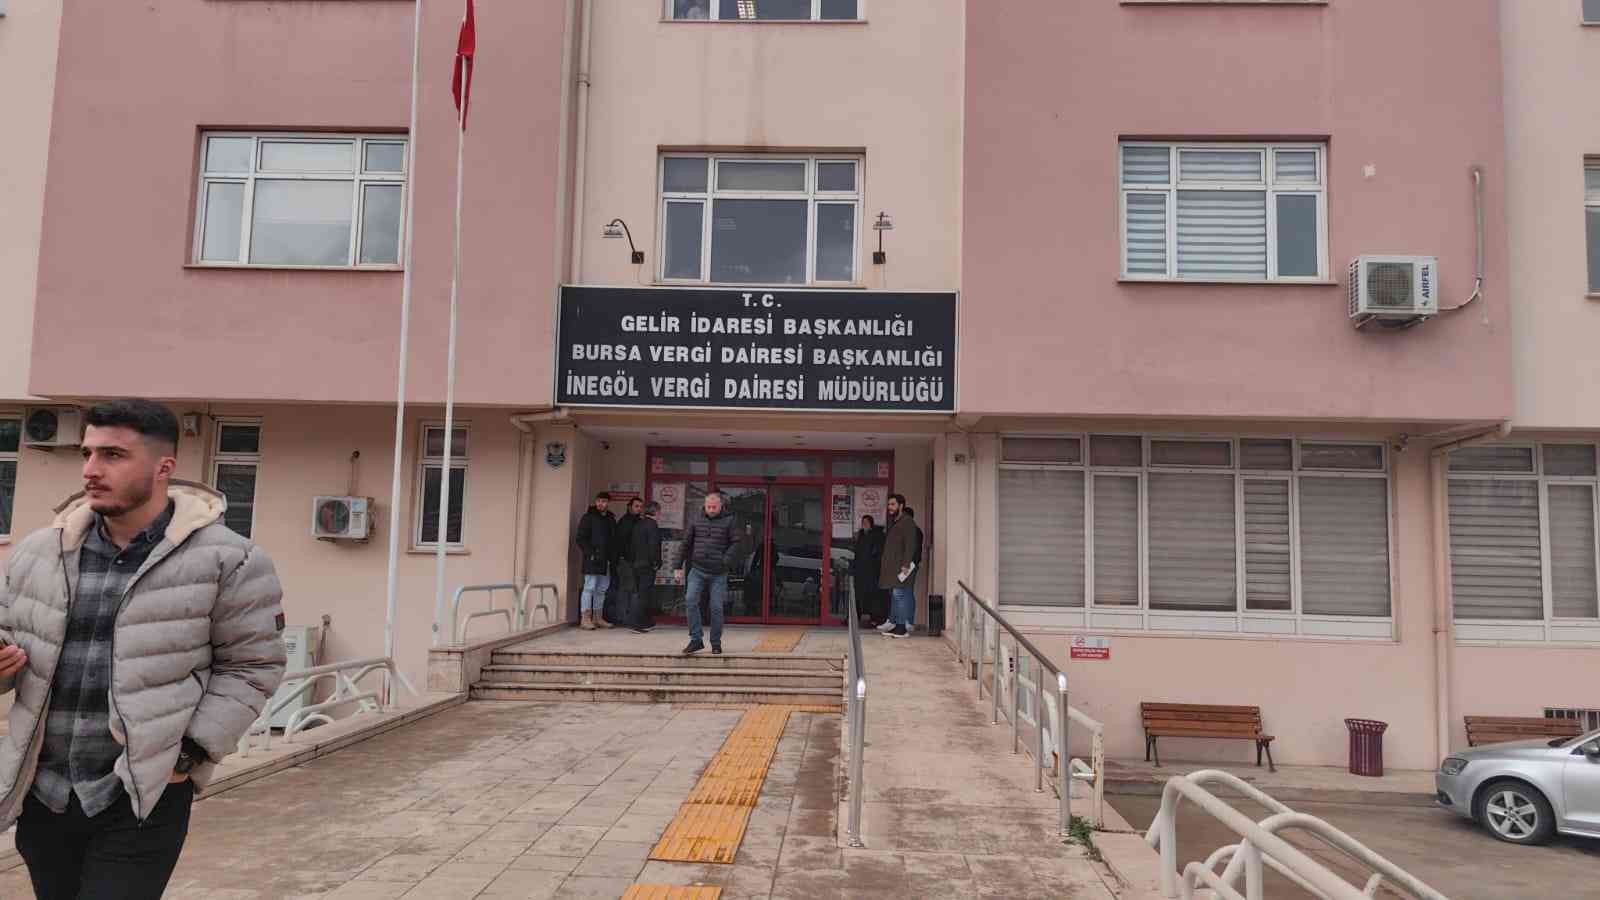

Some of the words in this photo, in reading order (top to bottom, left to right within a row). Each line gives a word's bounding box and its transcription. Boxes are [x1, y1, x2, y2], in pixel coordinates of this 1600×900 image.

[1421, 264, 1430, 298] AIRFEL
[621, 311, 680, 332] GELİR
[690, 312, 773, 335] İDARESİ
[783, 314, 914, 339] BAŞKANLIĞI
[572, 344, 642, 361] BURSA
[649, 341, 711, 363] VERGİ
[721, 342, 803, 365] DAİRESİ
[812, 345, 943, 370] BAŞKANLIĞI
[566, 369, 639, 396] İNEGÖL
[650, 372, 710, 398] VERGİ
[724, 373, 804, 400] DAİRESİ
[818, 376, 943, 402] MÜDÜRLÜĞÜ
